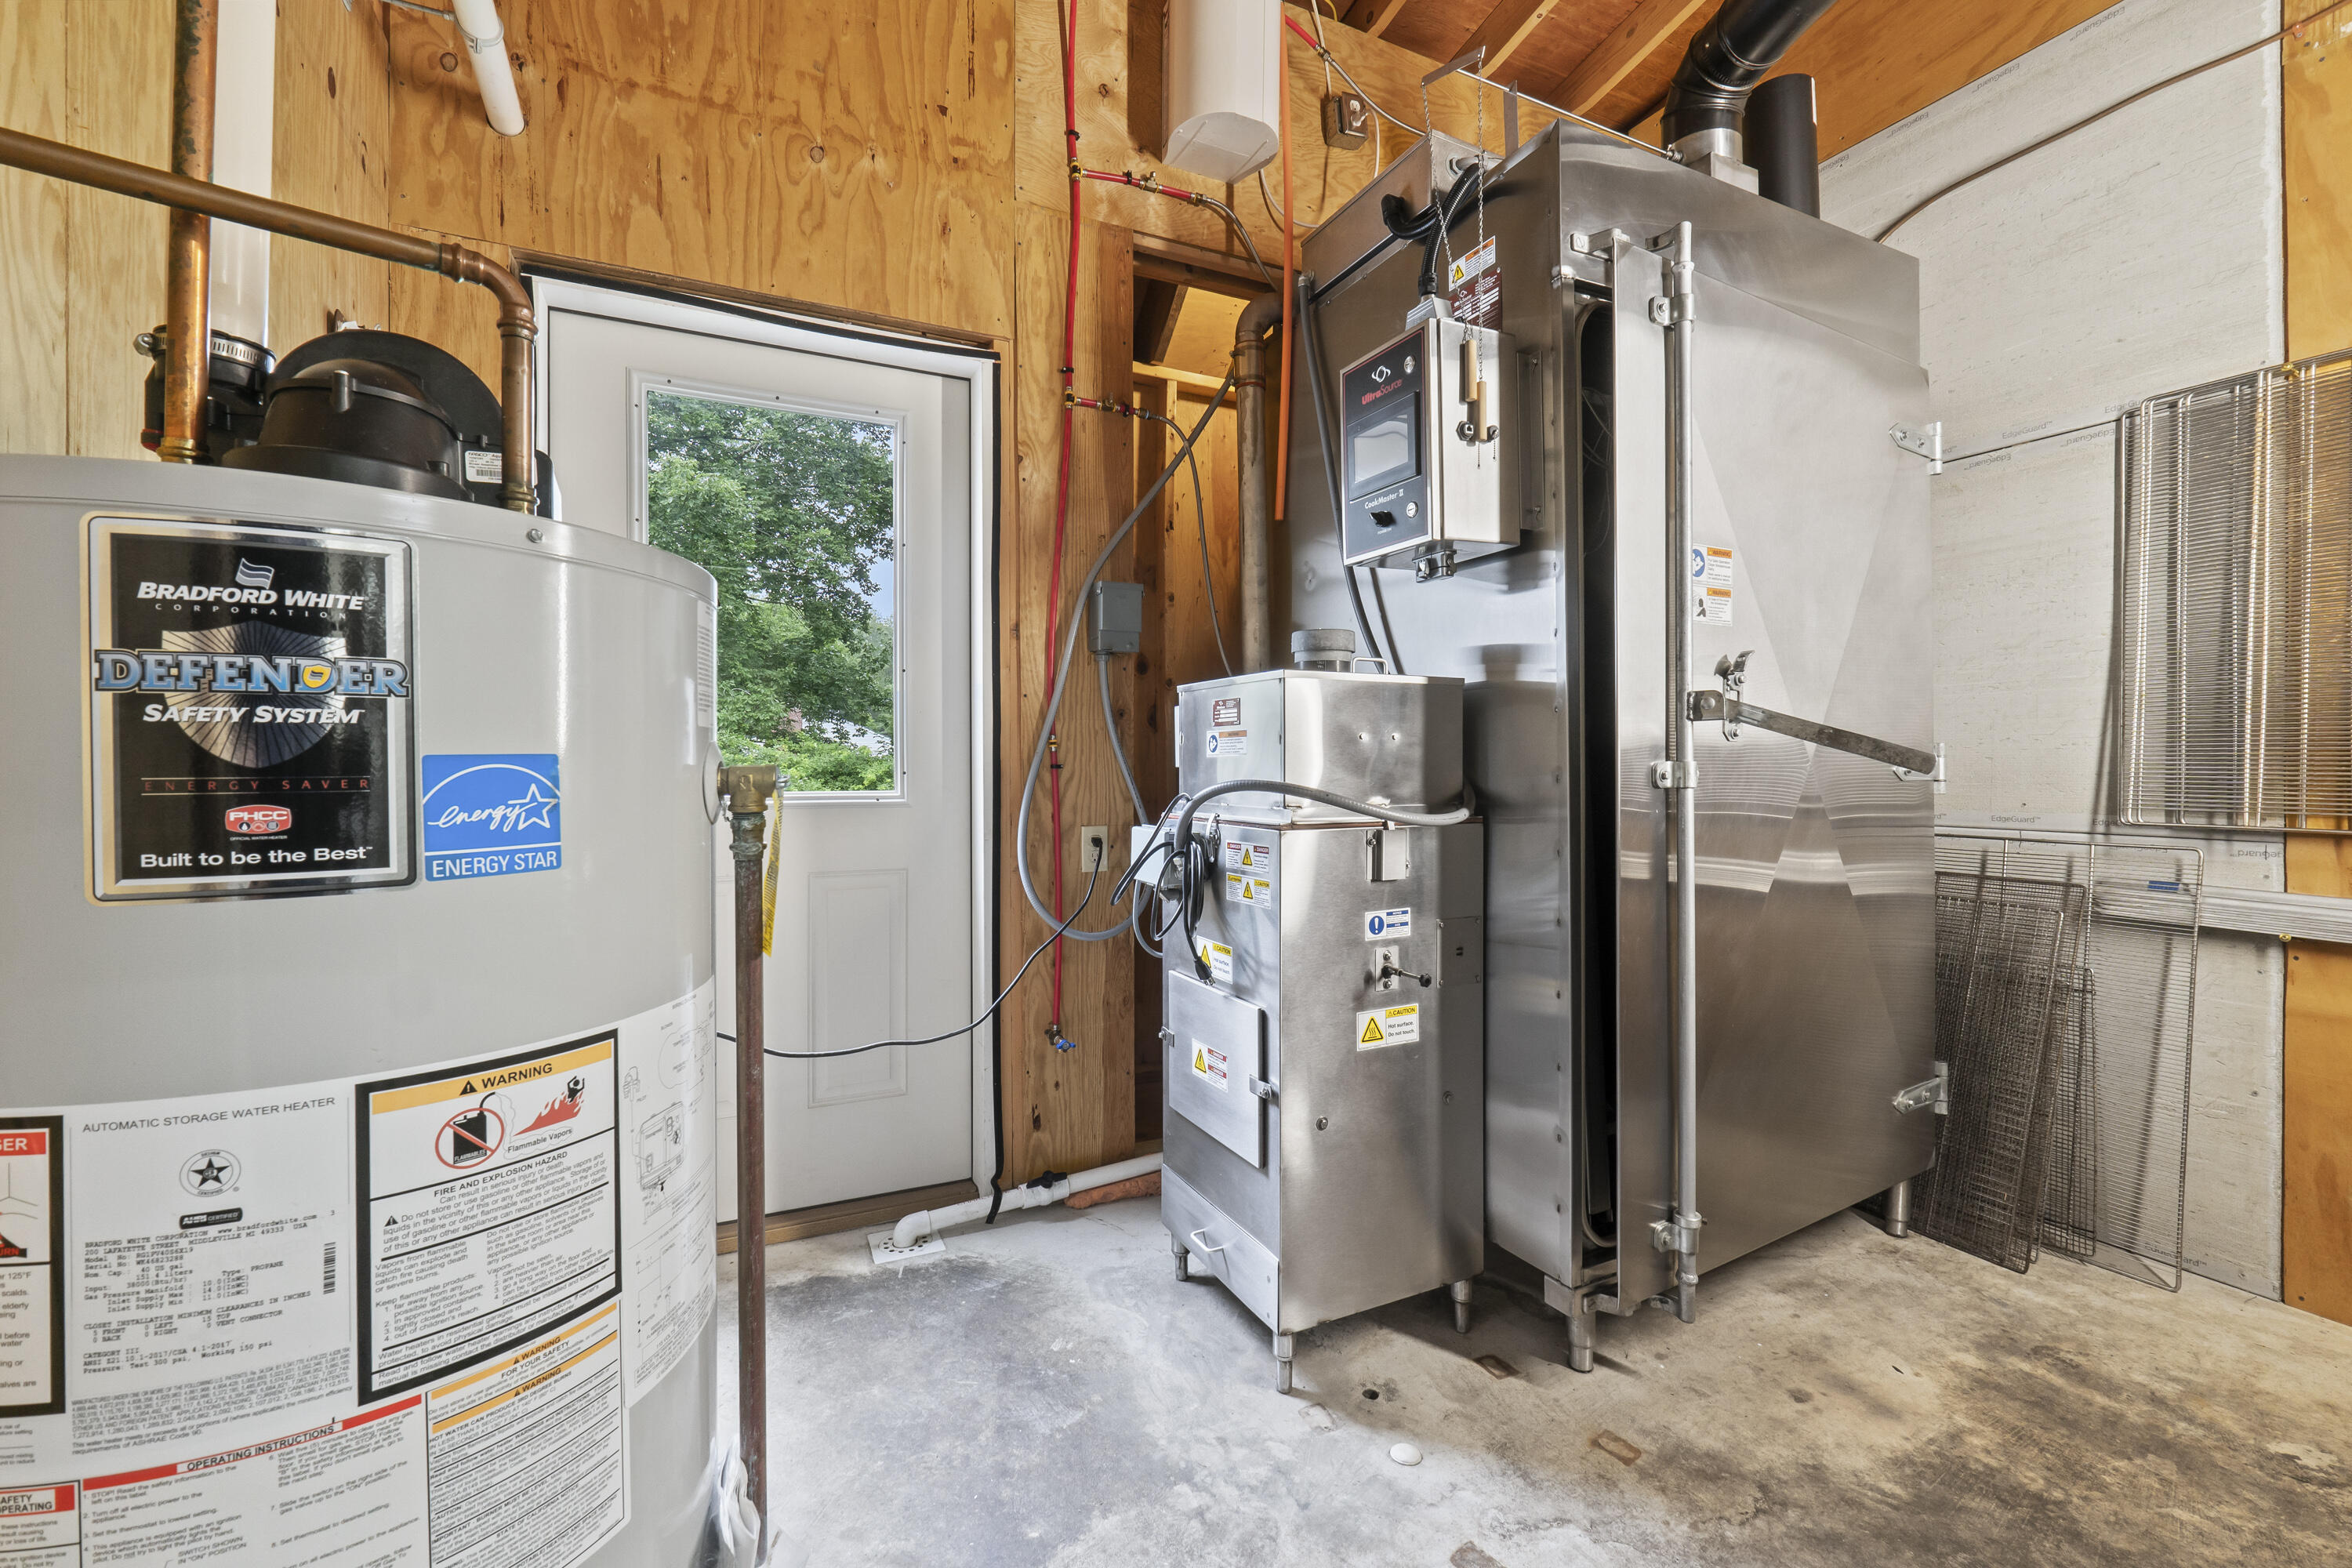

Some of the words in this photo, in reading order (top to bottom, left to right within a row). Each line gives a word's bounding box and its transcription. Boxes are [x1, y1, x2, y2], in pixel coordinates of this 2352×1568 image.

[1362, 379, 1403, 405] UltraSource
[136, 581, 278, 605] BRADFORD
[285, 590, 365, 611] WHITE
[154, 603, 347, 619] CORPORATION
[96, 651, 410, 697] DEFENDER
[143, 704, 250, 723] SAFETY
[144, 779, 259, 792] ENERGY
[282, 779, 369, 790] SAVER
[229, 811, 288, 821] PHCC
[427, 804, 522, 832] energy
[140, 853, 192, 868] Built
[198, 853, 224, 866] to
[231, 851, 261, 865] be
[268, 850, 307, 863] the
[433, 855, 510, 878] ENERGY
[514, 851, 557, 870] STAR
[481, 1062, 553, 1089] WARNING
[82, 1118, 160, 1133] AUTOMATIC
[163, 1111, 228, 1127] STORAGE
[232, 1104, 280, 1119] WATER
[283, 1097, 336, 1112] HEATER
[507, 1137, 547, 1153] Flammable
[549, 1127, 572, 1141] Vapors
[454, 1149, 486, 1162] FLAMMABLES
[416, 1210, 429, 1219] not
[431, 1204, 451, 1214] store
[480, 1185, 510, 1201] gasoline
[521, 1178, 538, 1188] other
[539, 1166, 572, 1178] flammable
[573, 1158, 592, 1169] vapors
[593, 1152, 604, 1160] and
[434, 1185, 456, 1197] FIRE
[459, 1179, 479, 1190] AND
[482, 1163, 533, 1184] EXPLOSION
[535, 1151, 568, 1167] HAZARD
[440, 1195, 456, 1204] Can
[459, 1189, 480, 1199] result
[490, 1176, 516, 1190] serious
[518, 1171, 536, 1181] injury
[546, 1160, 564, 1171] death
[85, 1240, 122, 1248] BRADFORD
[155, 1230, 209, 1242] CORPORATION
[103, 1244, 146, 1254] LAFAYETTE
[151, 1241, 180, 1250] STREET
[188, 1232, 241, 1246] MIDDLEVILLE
[261, 1226, 284, 1235] 49333
[251, 1261, 283, 1272] PROPANE
[103, 1290, 140, 1299] Pressure
[145, 1285, 183, 1294] Manifold
[83, 1321, 112, 1330] CLOSET
[117, 1315, 174, 1327] INSTALLATION
[177, 1309, 212, 1321] MINIMUM
[216, 1300, 264, 1314] CLEARANCES
[283, 1291, 311, 1301] INCHES
[83, 1349, 121, 1359] CATEGORY
[201, 1348, 235, 1359] Working
[239, 1343, 254, 1352] 150
[258, 1341, 272, 1350] psi
[501, 1367, 517, 1379] FOR
[520, 1358, 541, 1371] YOUR
[543, 1341, 569, 1359] SAFETY
[521, 1336, 561, 1361] WARNING
[522, 1367, 562, 1392] WARNING
[187, 1448, 252, 1472] OPERATING
[254, 1426, 334, 1455] INSTRUCTIONS
